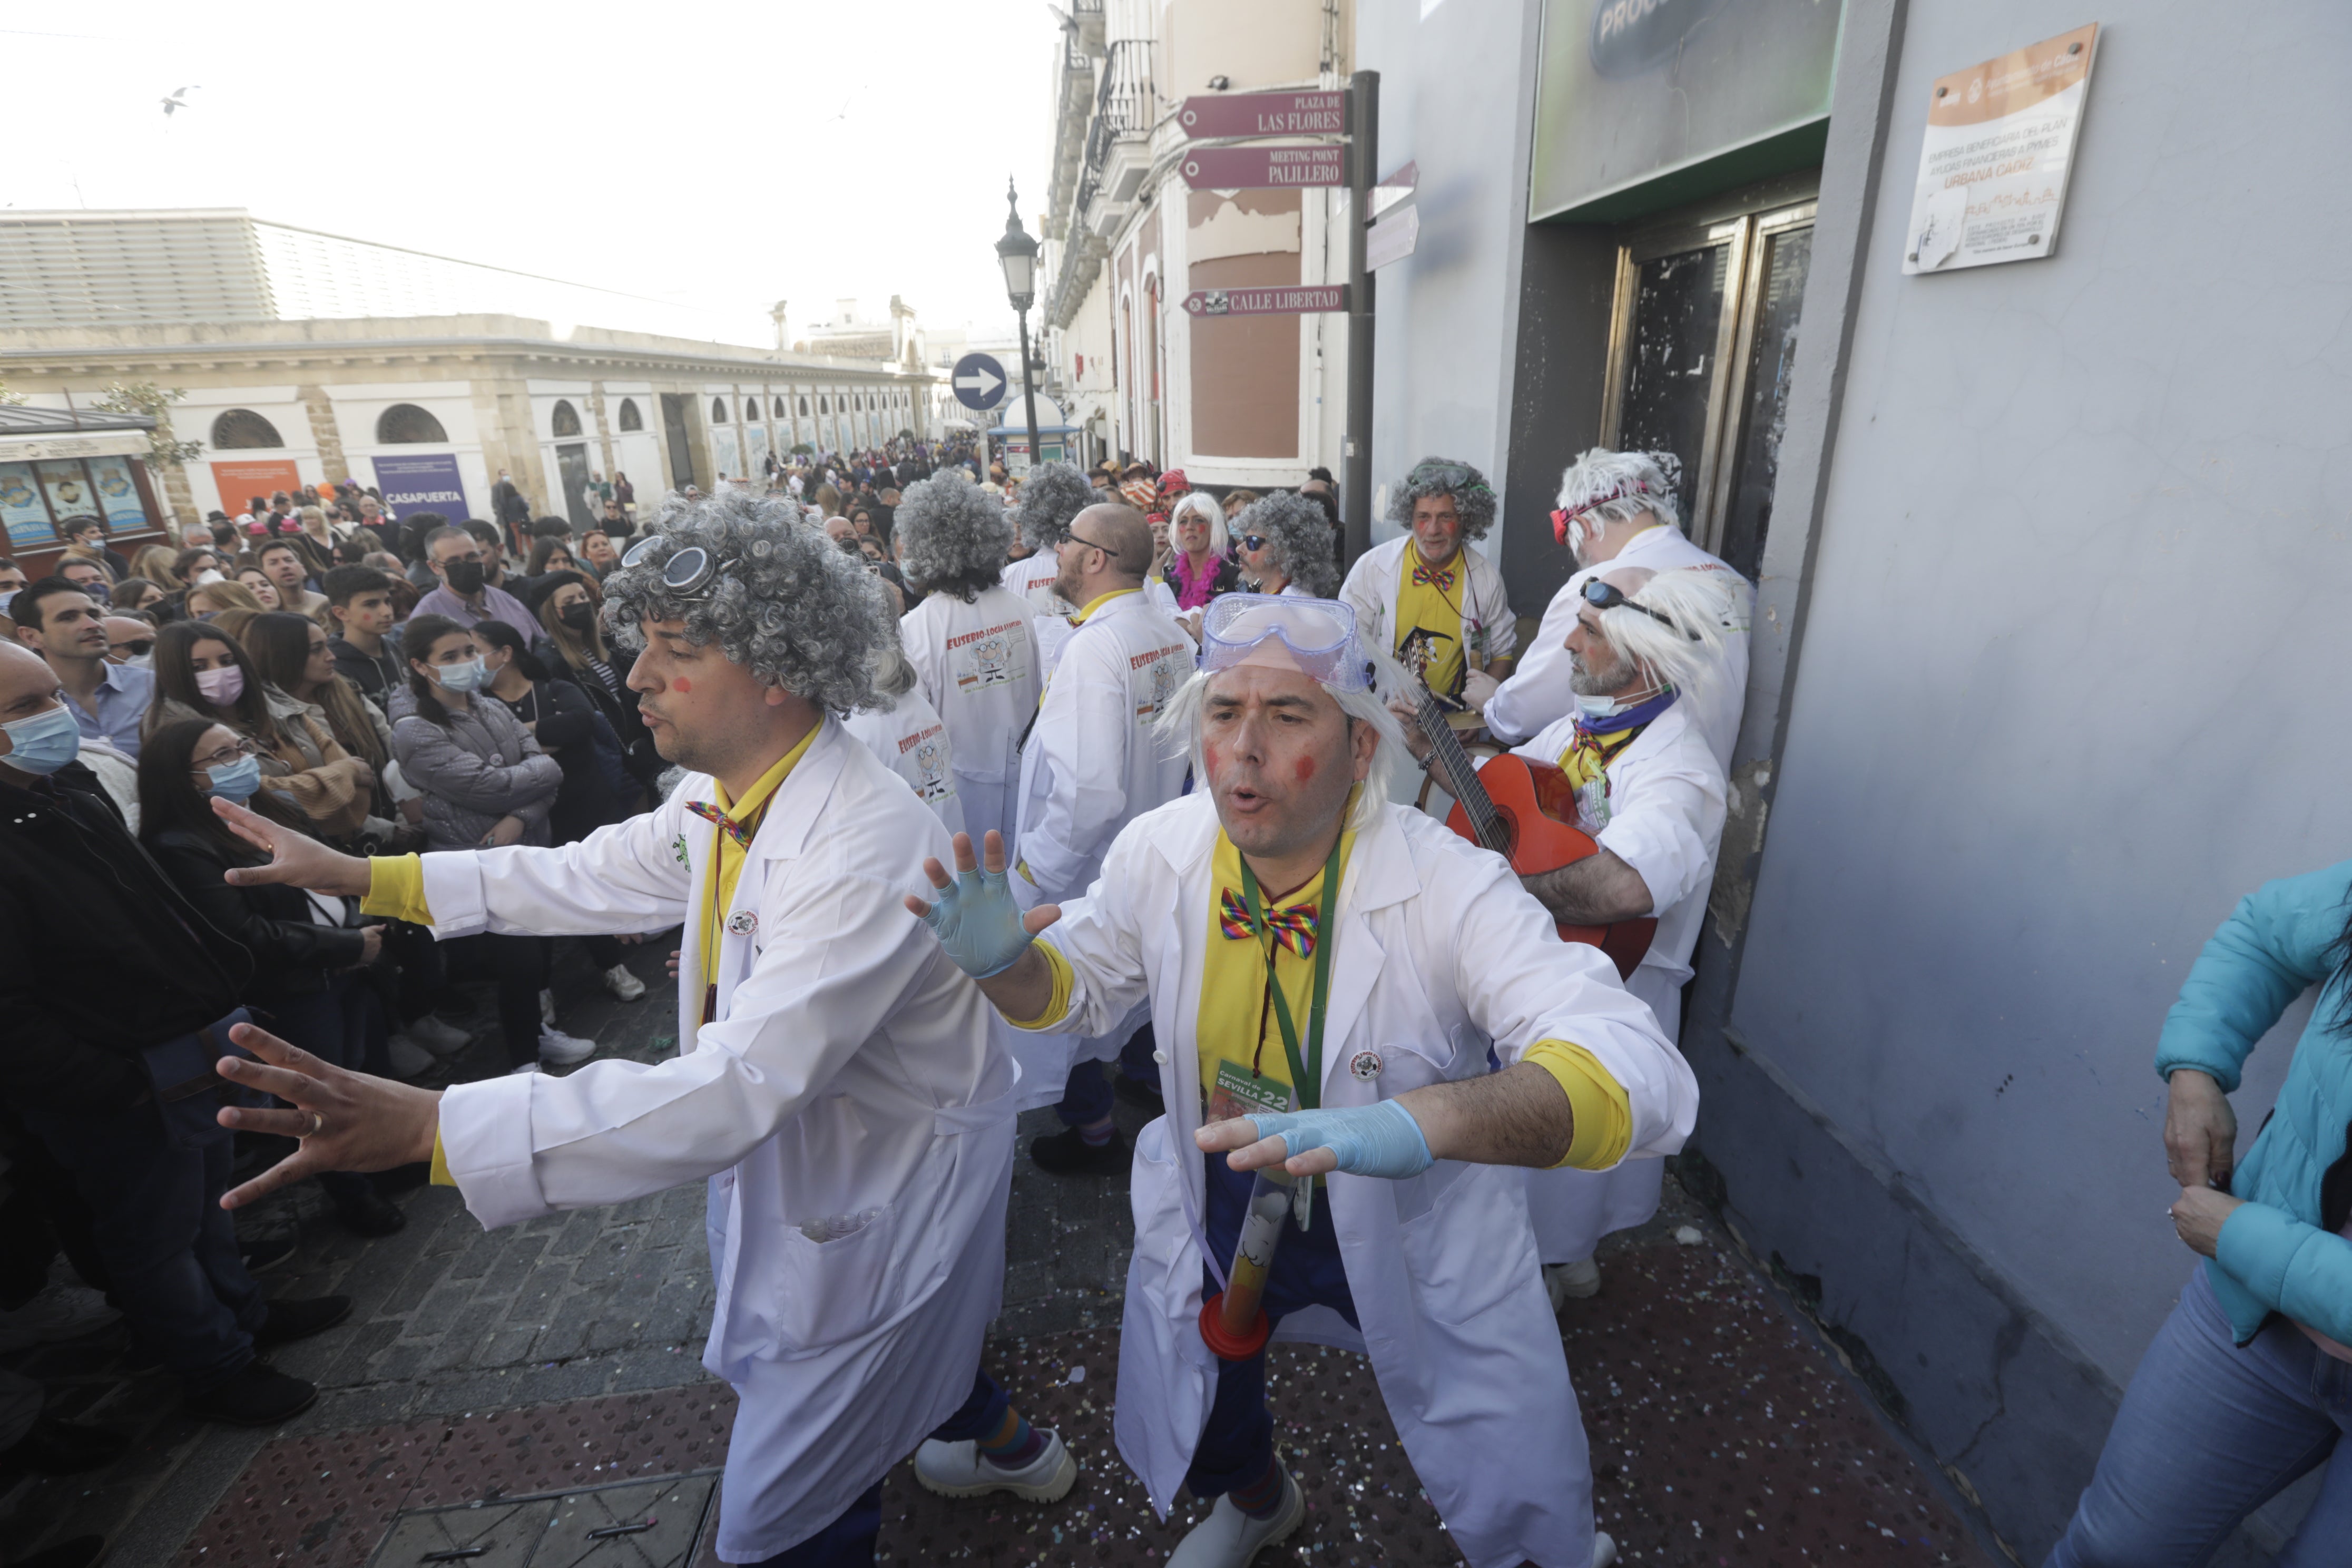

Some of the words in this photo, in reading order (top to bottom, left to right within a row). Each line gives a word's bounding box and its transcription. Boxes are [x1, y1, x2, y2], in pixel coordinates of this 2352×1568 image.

[1295, 96, 1325, 110] PLAZA
[1327, 96, 1340, 108] DE
[1258, 113, 1285, 132] LAS
[1288, 112, 1340, 131] FLORES
[1928, 145, 1965, 163] EMPRESA
[1966, 131, 2021, 153] BENEFICIARIA
[2023, 125, 2040, 139] DEL
[2041, 118, 2067, 134] PLAN
[1270, 150, 1310, 163] MEETING
[1312, 150, 1339, 162] POINT
[1930, 160, 1961, 176] AYUDAS
[1963, 146, 2015, 168] FINANCIERAS
[2016, 144, 2025, 155] A
[2026, 136, 2059, 153] PYMES
[1269, 164, 1339, 184] PALILLERO
[1944, 166, 1993, 189] URBANA
[1231, 293, 1272, 311] CALLE
[1276, 291, 1339, 309] LIBERTAD
[386, 491, 462, 504] CASAPUERTA
[1217, 1077, 1258, 1100] SEVILLA
[1260, 1091, 1288, 1111] 22
[1252, 1082, 1261, 1091] de
